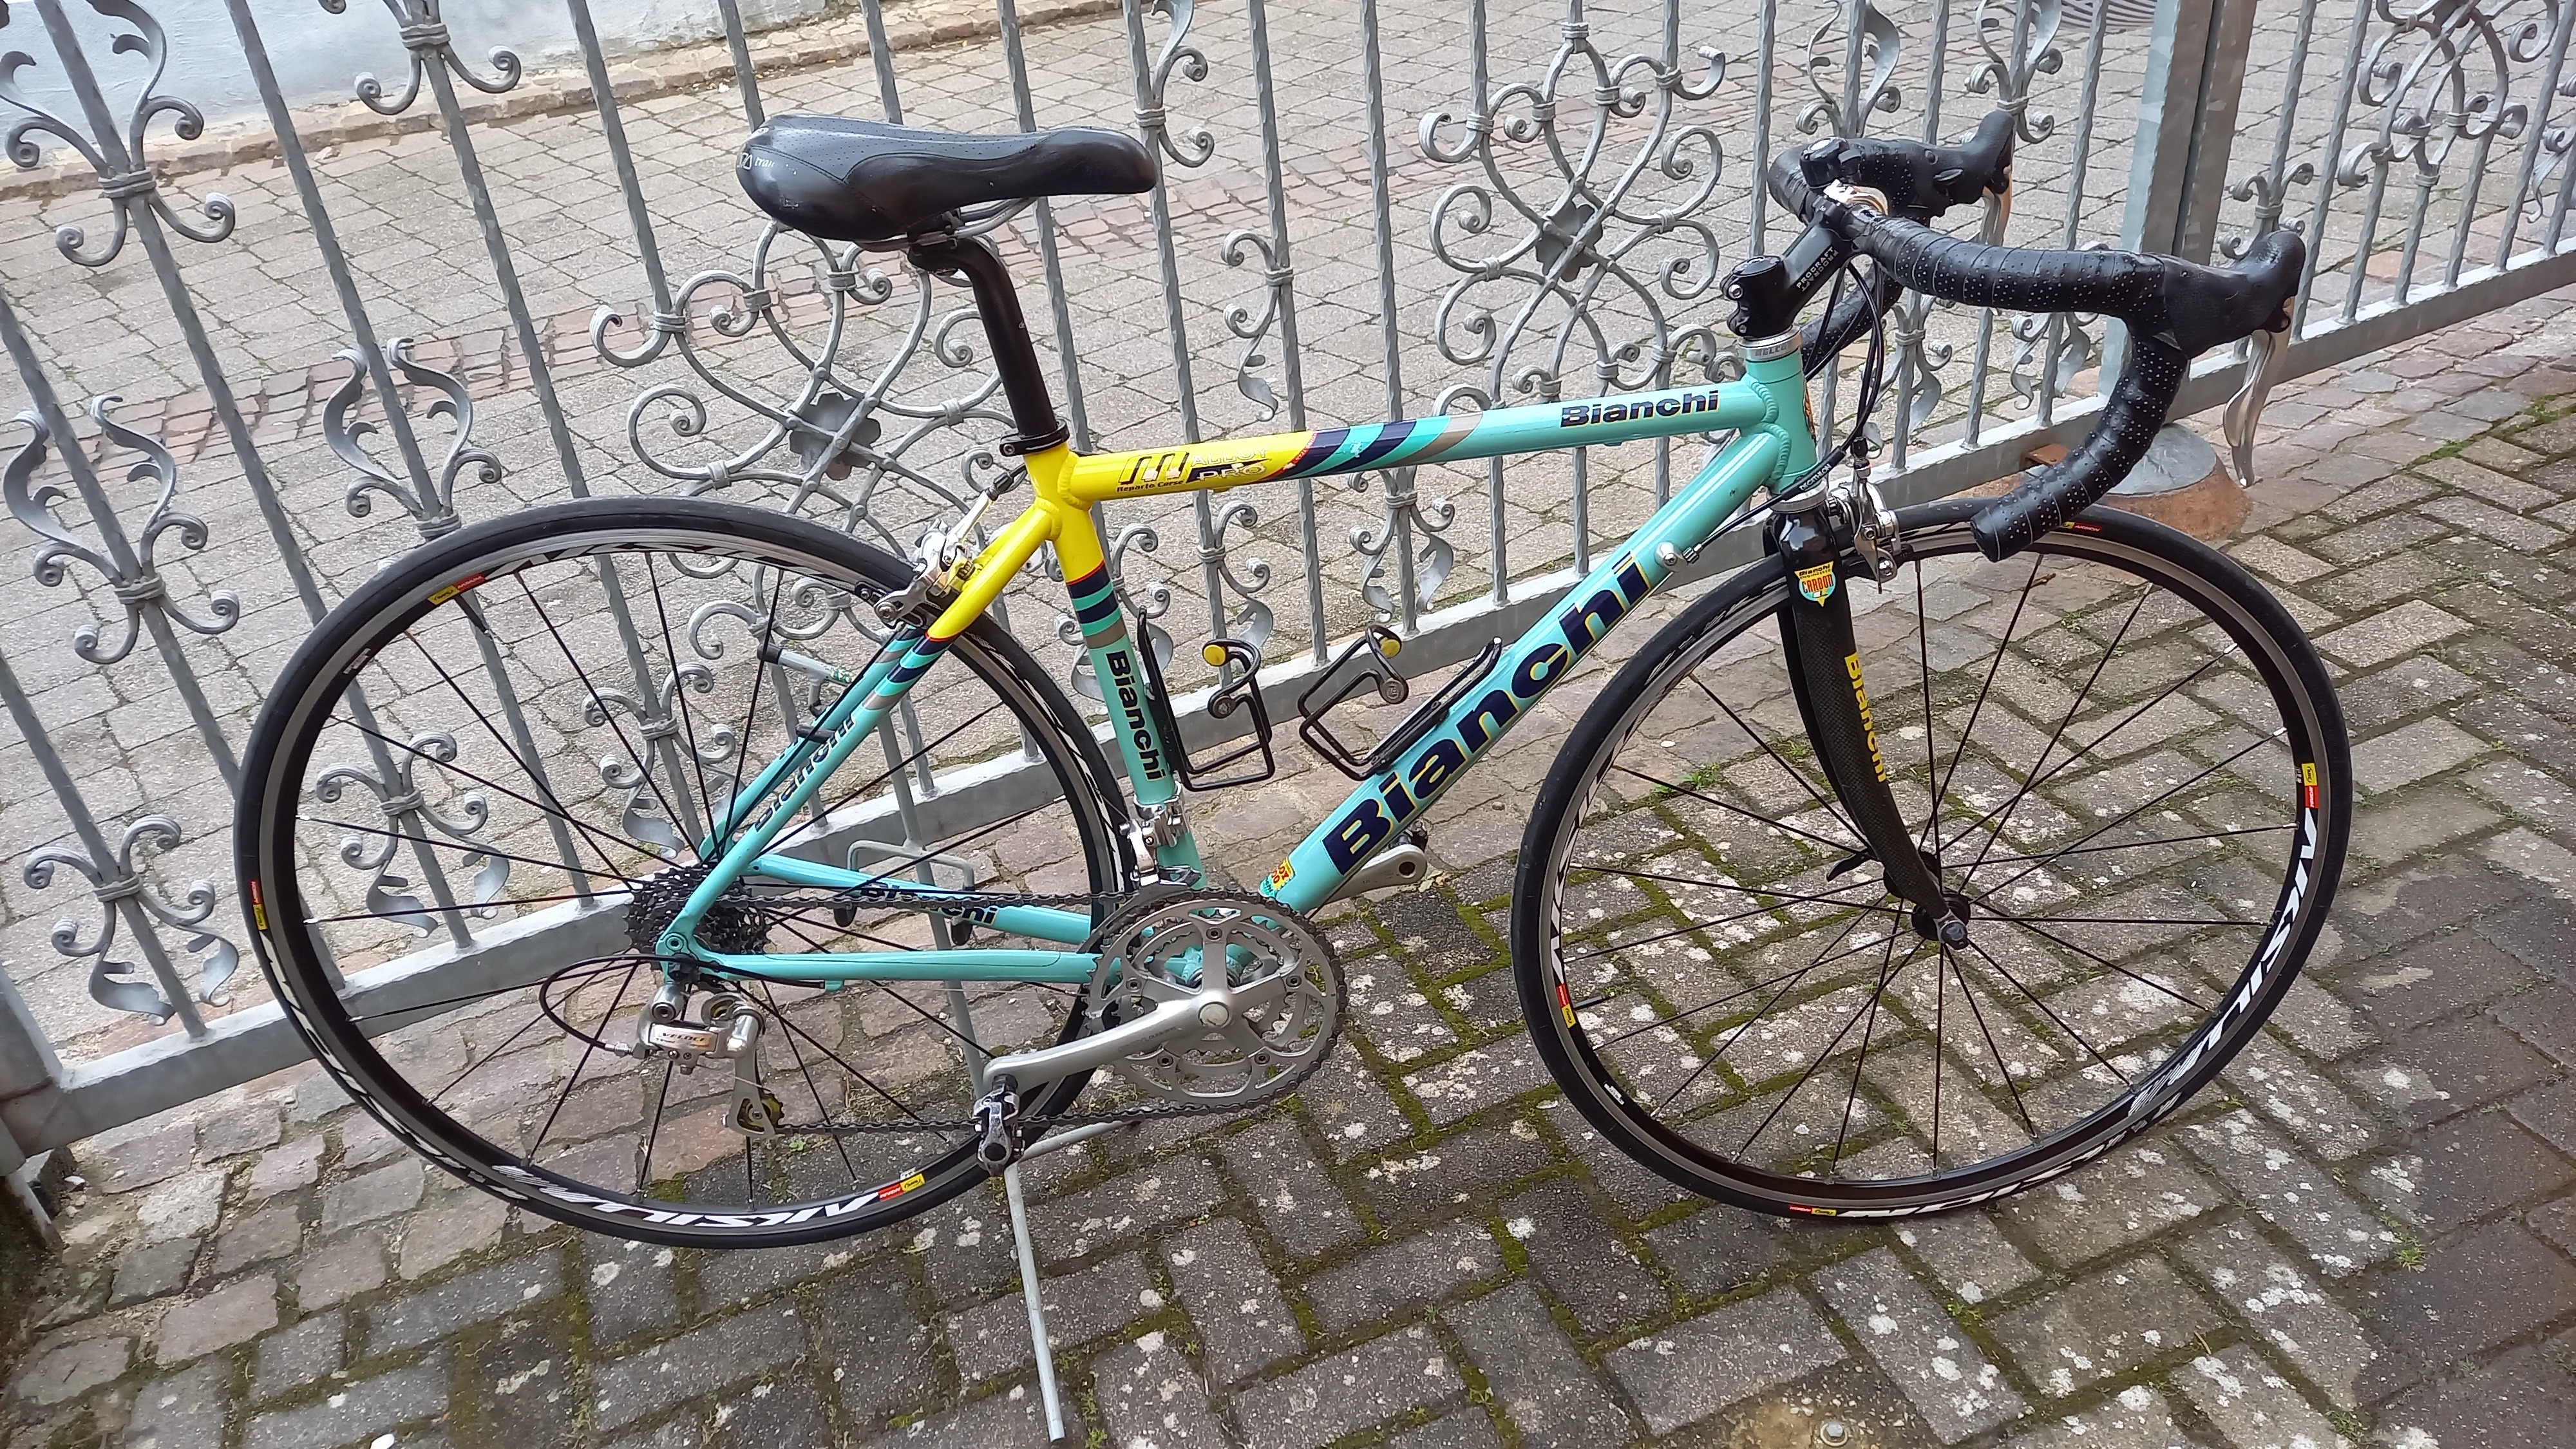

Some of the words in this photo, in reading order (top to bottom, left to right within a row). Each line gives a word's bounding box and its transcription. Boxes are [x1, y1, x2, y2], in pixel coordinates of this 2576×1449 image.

[1796, 247, 1833, 289] PROCRAFT
[1560, 390, 1719, 428] Bianchi
[1192, 446, 1269, 467] ALLOY
[1197, 463, 1267, 481] PRO
[1116, 483, 1155, 493] Reparto
[1799, 463, 1832, 491] DECATHLON
[1802, 574, 1834, 594] CARBON
[1106, 650, 1166, 782] Bianchi
[1322, 551, 1653, 876] Bianchi
[1844, 651, 1886, 783] Bianchi
